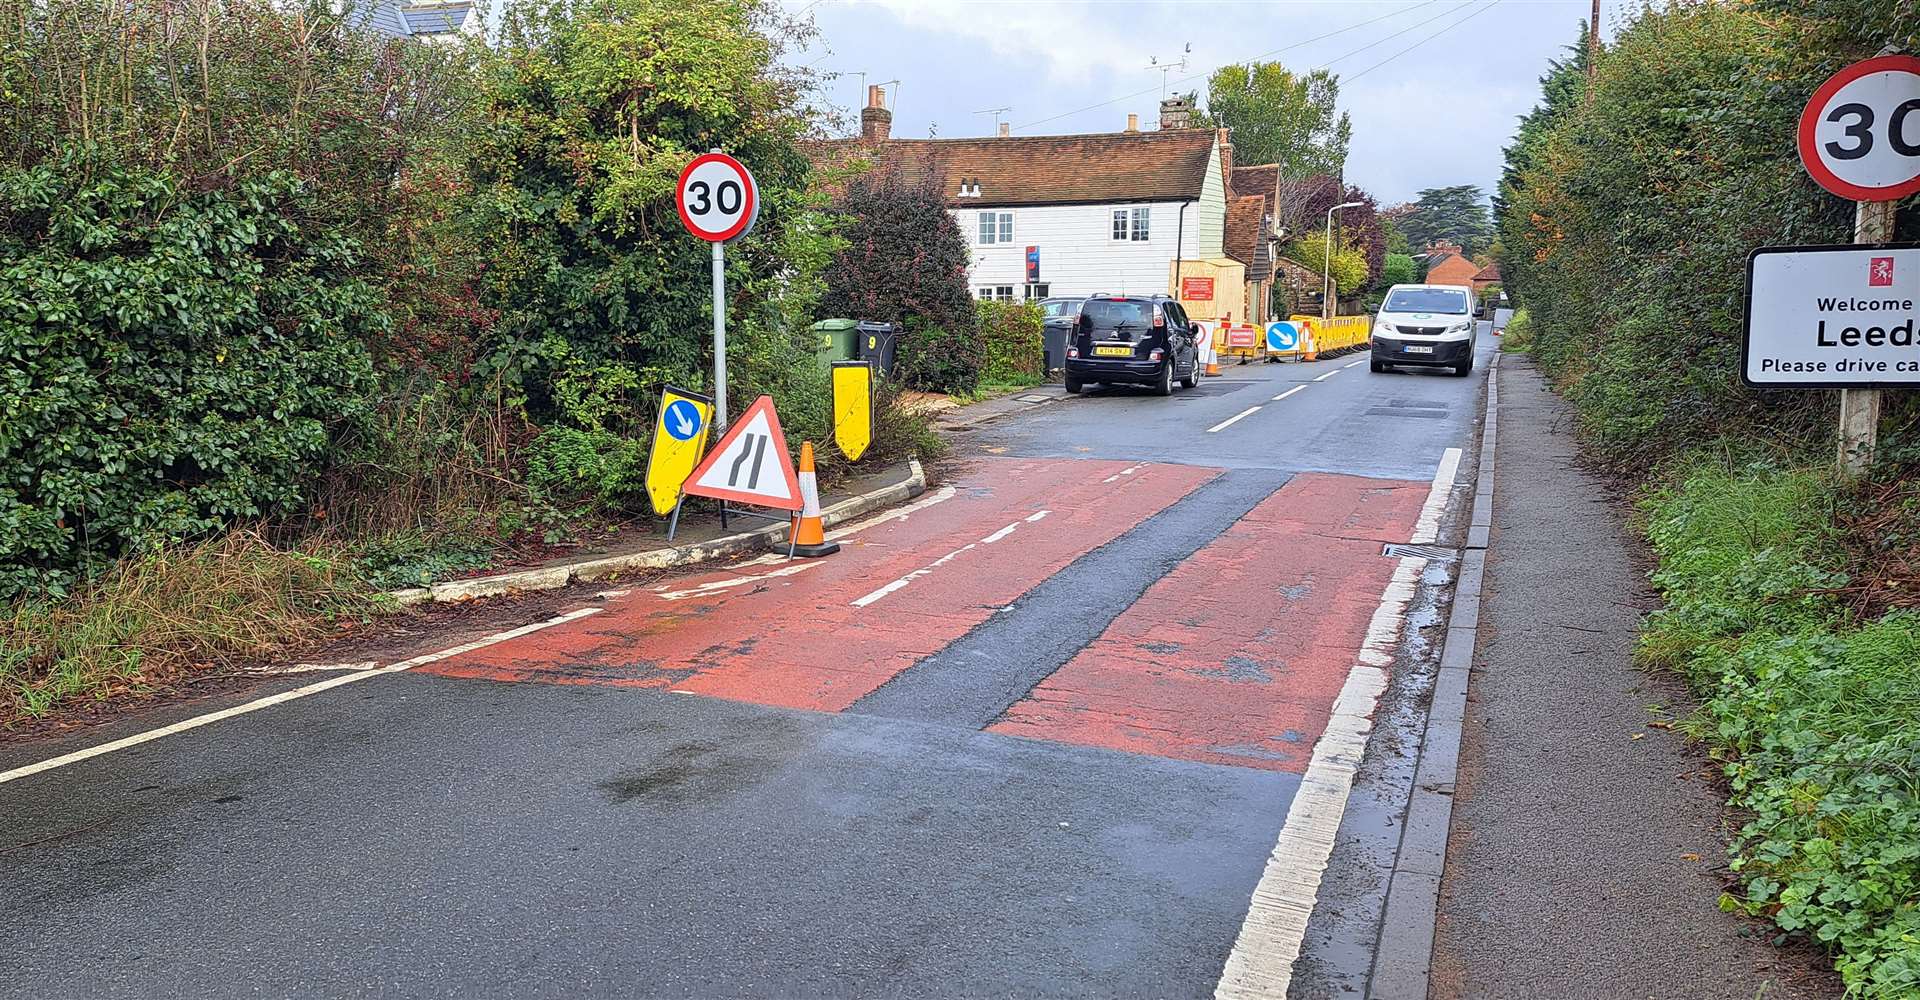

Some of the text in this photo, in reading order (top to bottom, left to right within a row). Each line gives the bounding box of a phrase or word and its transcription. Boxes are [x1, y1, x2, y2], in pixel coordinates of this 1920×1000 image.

[1825, 99, 1920, 160] 30
[688, 180, 742, 215] 30
[1817, 298, 1913, 312] Welcome
[825, 334, 832, 347] 9
[868, 336, 876, 350] 9
[1761, 359, 1827, 372] Please
[1835, 358, 1887, 372] drive
